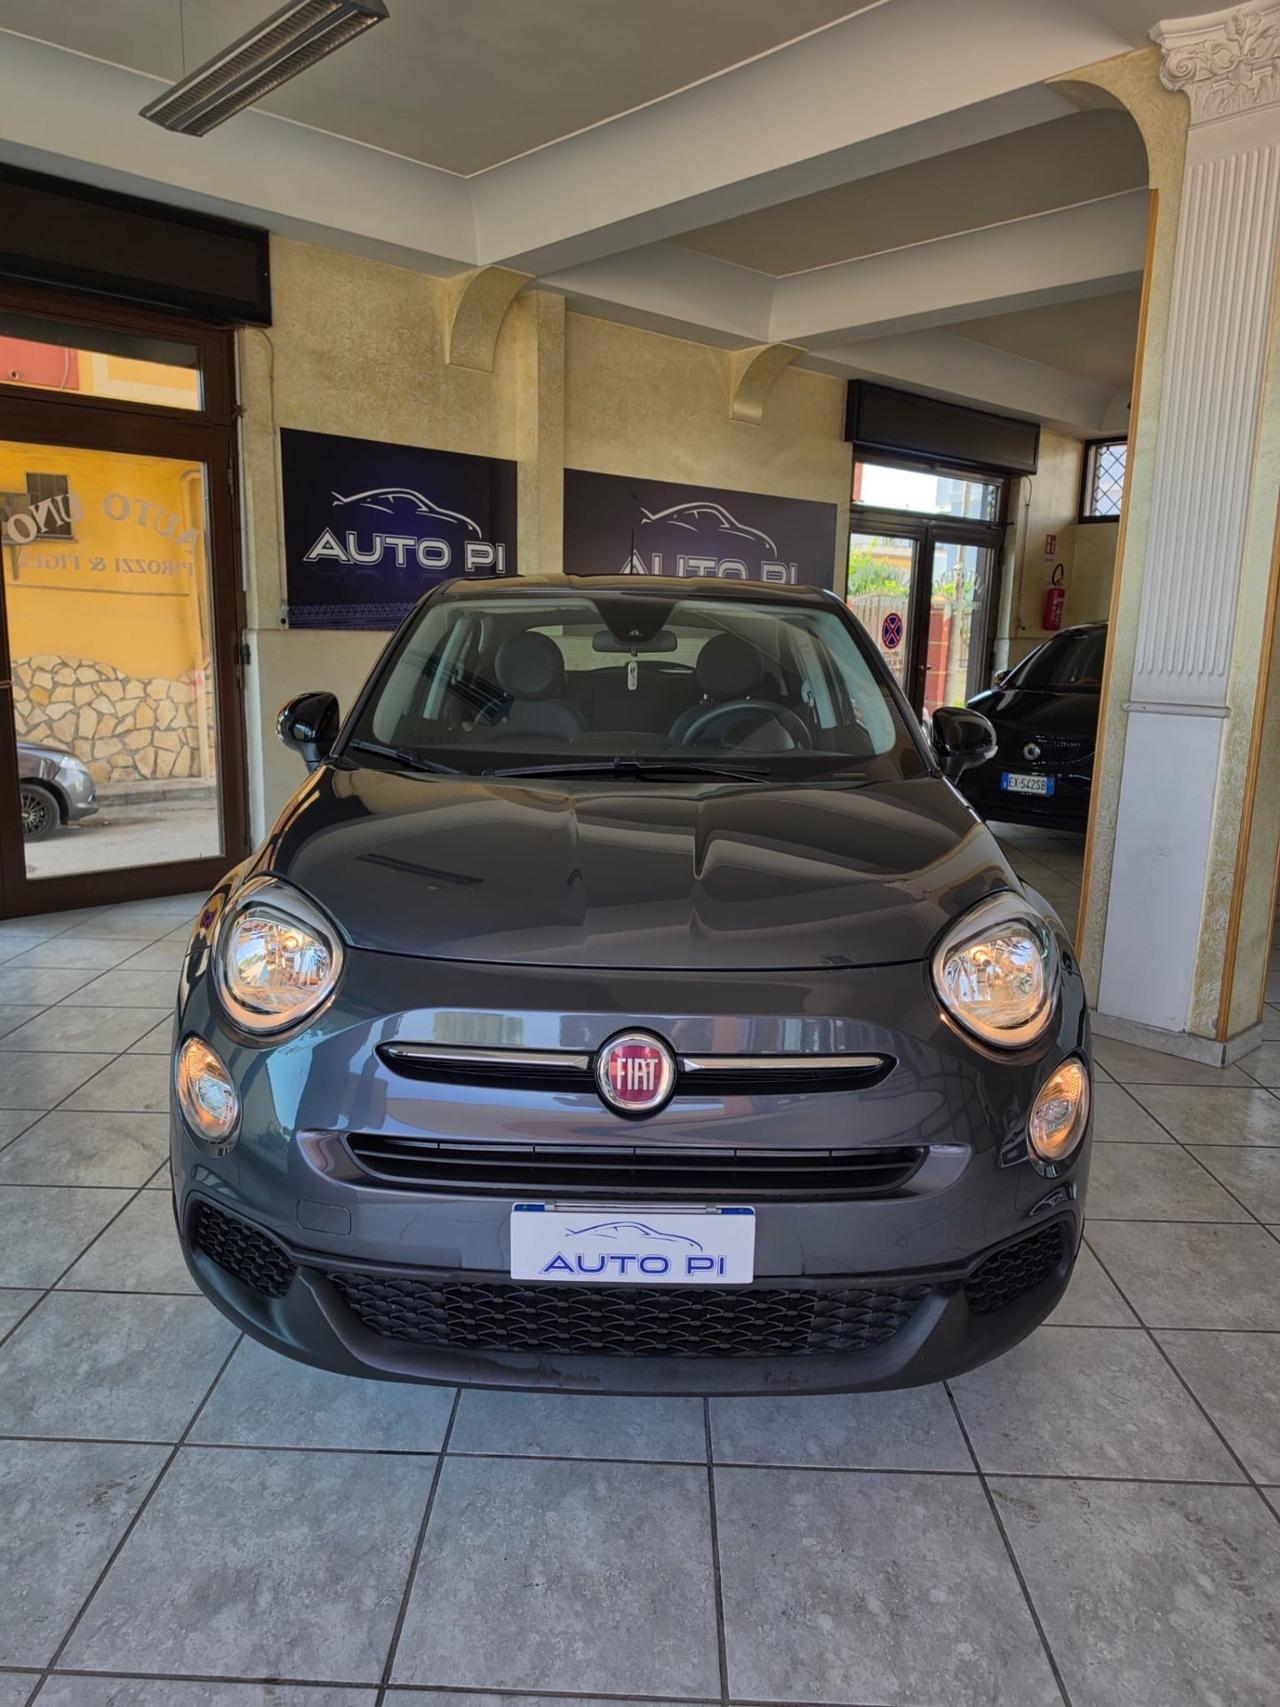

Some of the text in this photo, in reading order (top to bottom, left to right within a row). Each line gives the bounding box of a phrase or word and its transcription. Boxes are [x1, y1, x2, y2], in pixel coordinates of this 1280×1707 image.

[303, 527, 506, 574] AUTO PI
[616, 1057, 659, 1091] FIAT
[538, 1251, 727, 1278] AUTO PI
